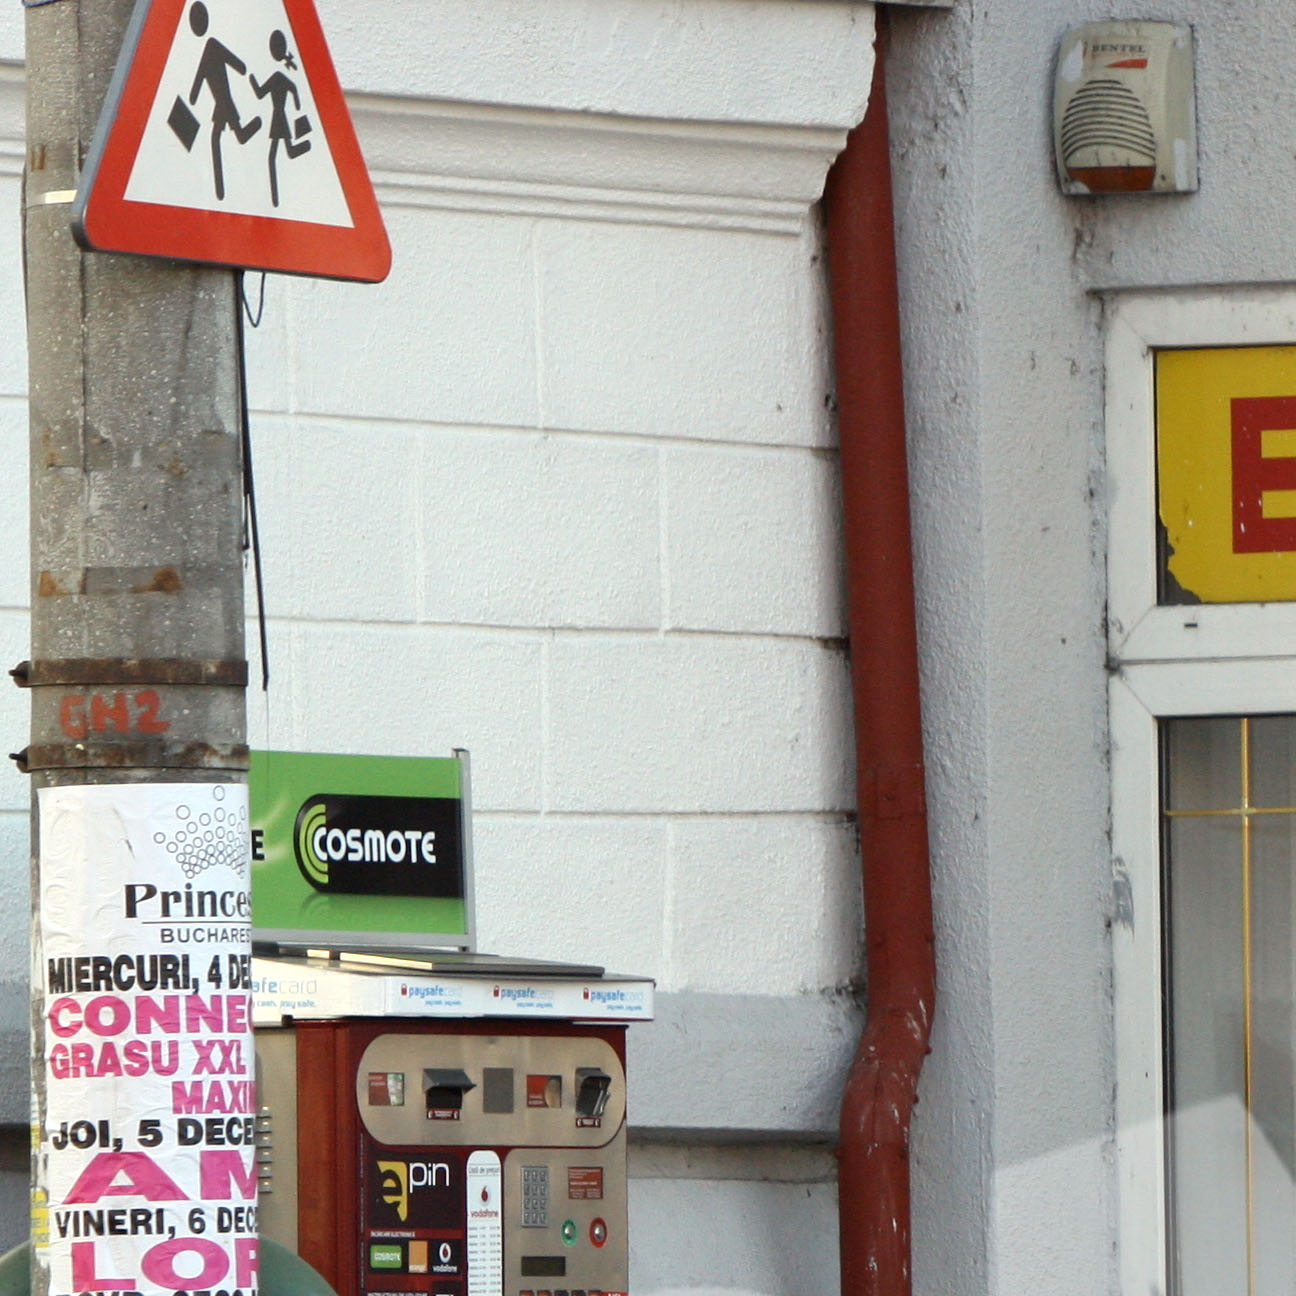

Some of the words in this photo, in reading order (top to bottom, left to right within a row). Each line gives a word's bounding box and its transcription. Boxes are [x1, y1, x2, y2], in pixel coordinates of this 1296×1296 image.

[313, 826, 437, 864] COSMOTE
[48, 954, 200, 995] MIERCURI,
[207, 955, 222, 990] 4
[50, 1040, 179, 1080] GRASU
[191, 1039, 246, 1075] XXL
[52, 1119, 123, 1151] JOI,
[137, 1119, 163, 1148] 5
[55, 1208, 176, 1239] VINERI,
[188, 1207, 206, 1234] 6
